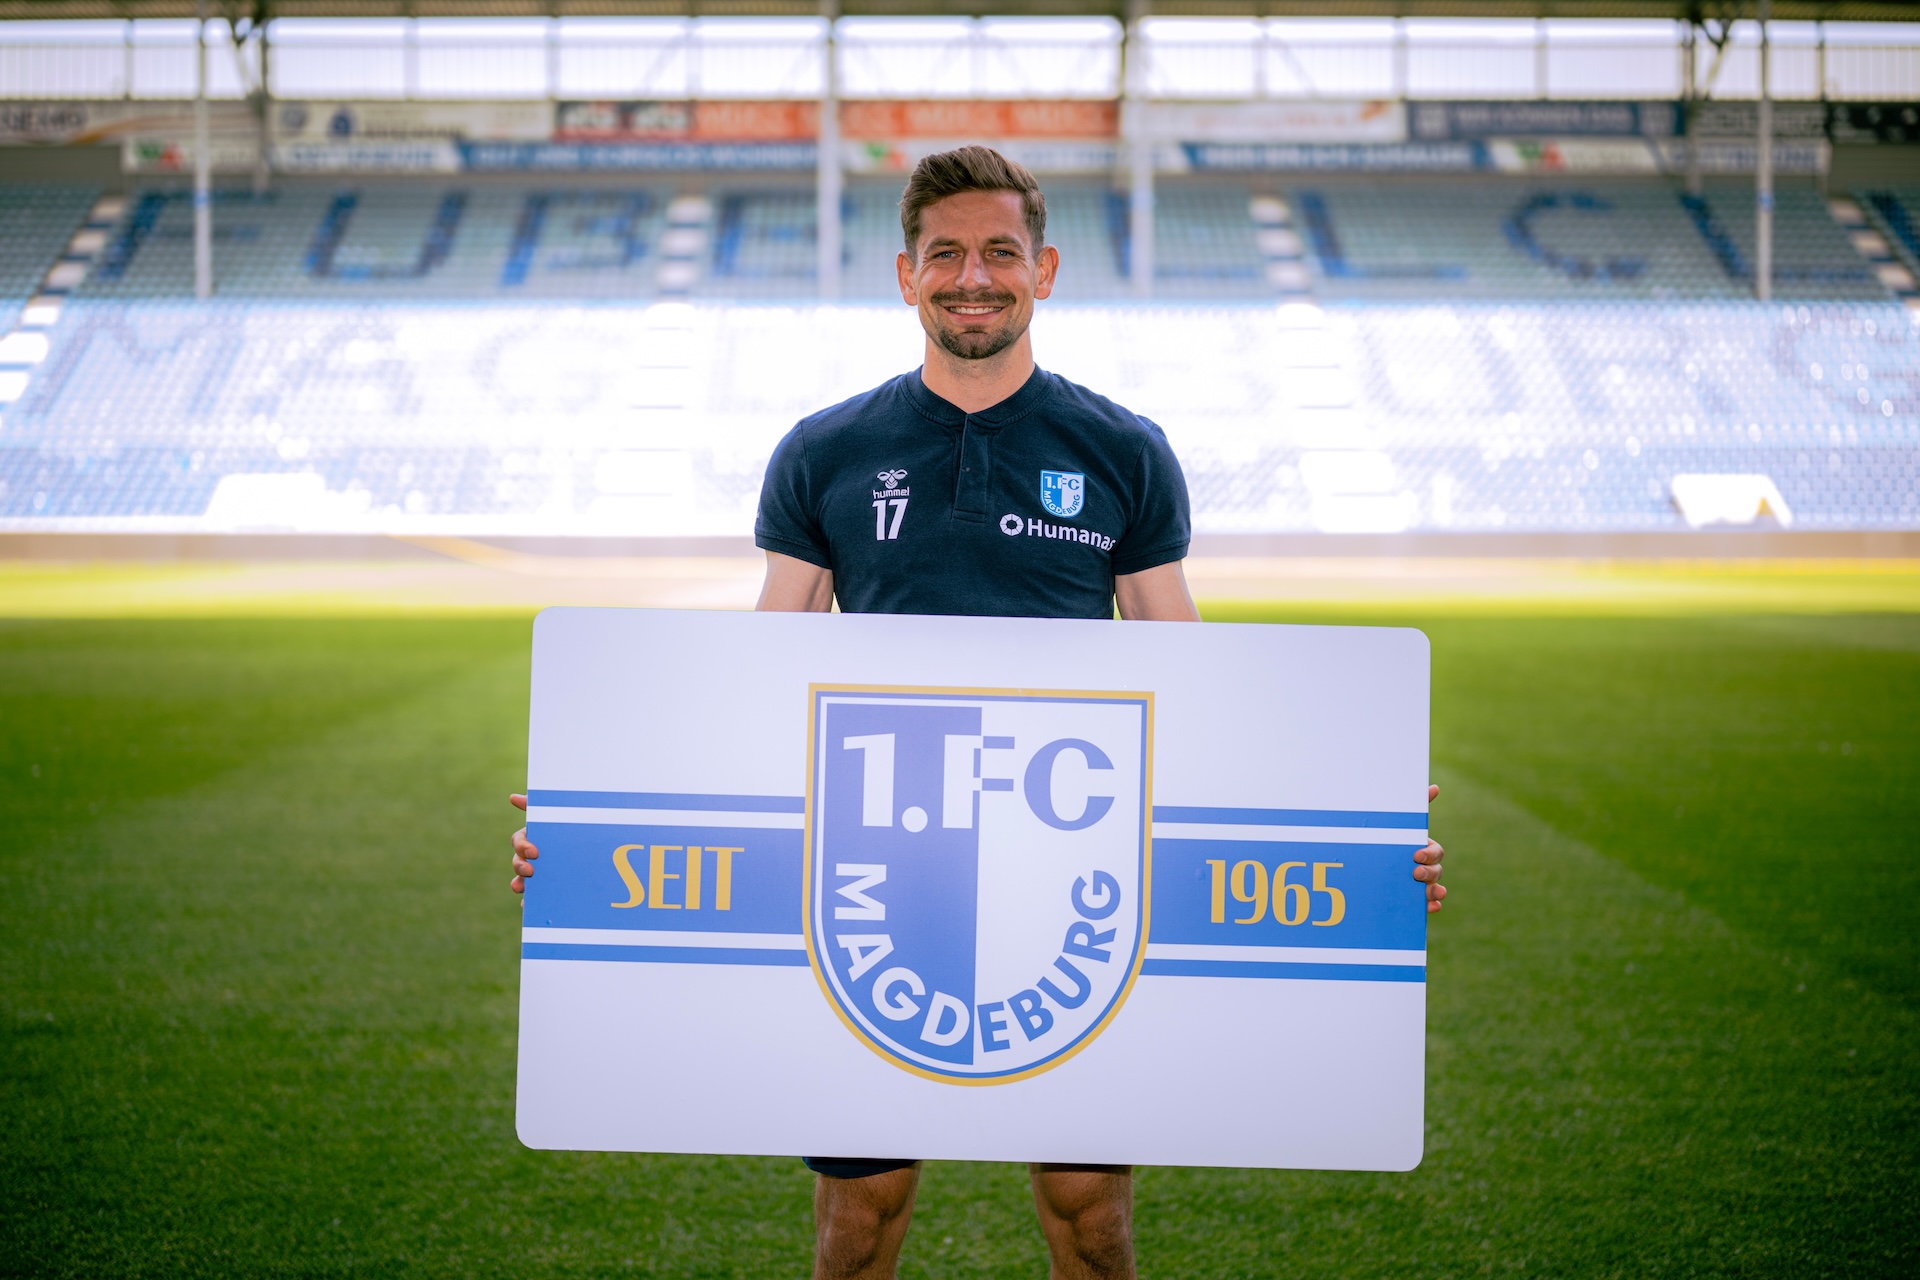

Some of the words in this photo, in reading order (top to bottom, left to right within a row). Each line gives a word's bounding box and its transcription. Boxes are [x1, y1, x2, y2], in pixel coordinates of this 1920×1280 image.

[872, 486, 910, 499] hummel
[1043, 490, 1081, 515] MAGDEBURG
[872, 499, 909, 541] 17
[610, 844, 745, 911] SEIT
[1205, 859, 1346, 926] 1965
[834, 863, 1121, 1053] MAGDEBURG
